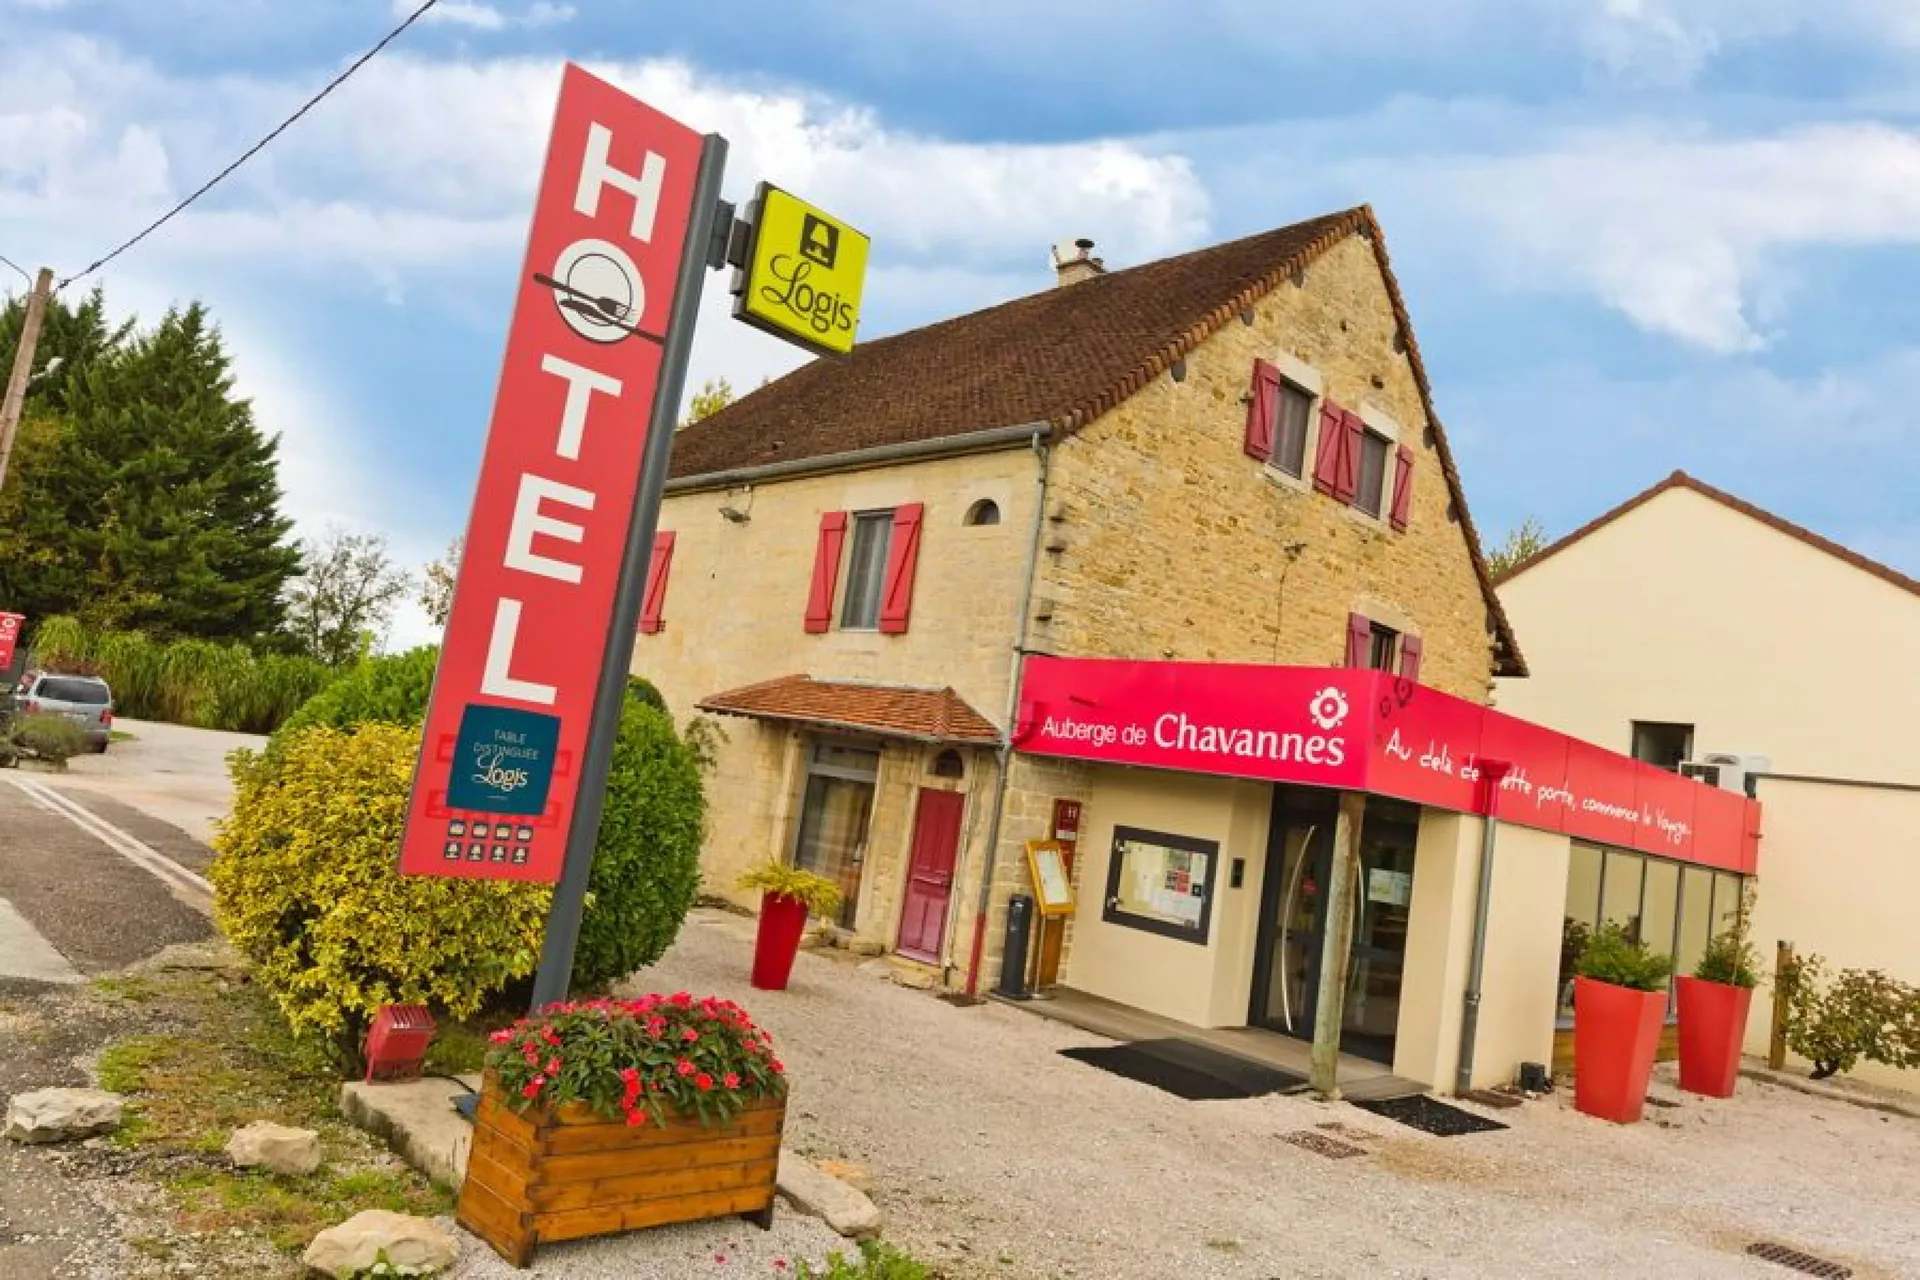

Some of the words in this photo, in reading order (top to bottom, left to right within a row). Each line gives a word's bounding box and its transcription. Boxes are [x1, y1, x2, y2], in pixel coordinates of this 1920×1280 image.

[761, 253, 852, 333] Logis
[480, 120, 667, 706] HOTEL
[1041, 716, 1117, 747] Auberge
[1122, 723, 1148, 746] de
[1154, 712, 1346, 766] Chavannes
[1384, 727, 1412, 761] Au
[1460, 753, 1479, 782] de
[471, 750, 529, 792] Logis
